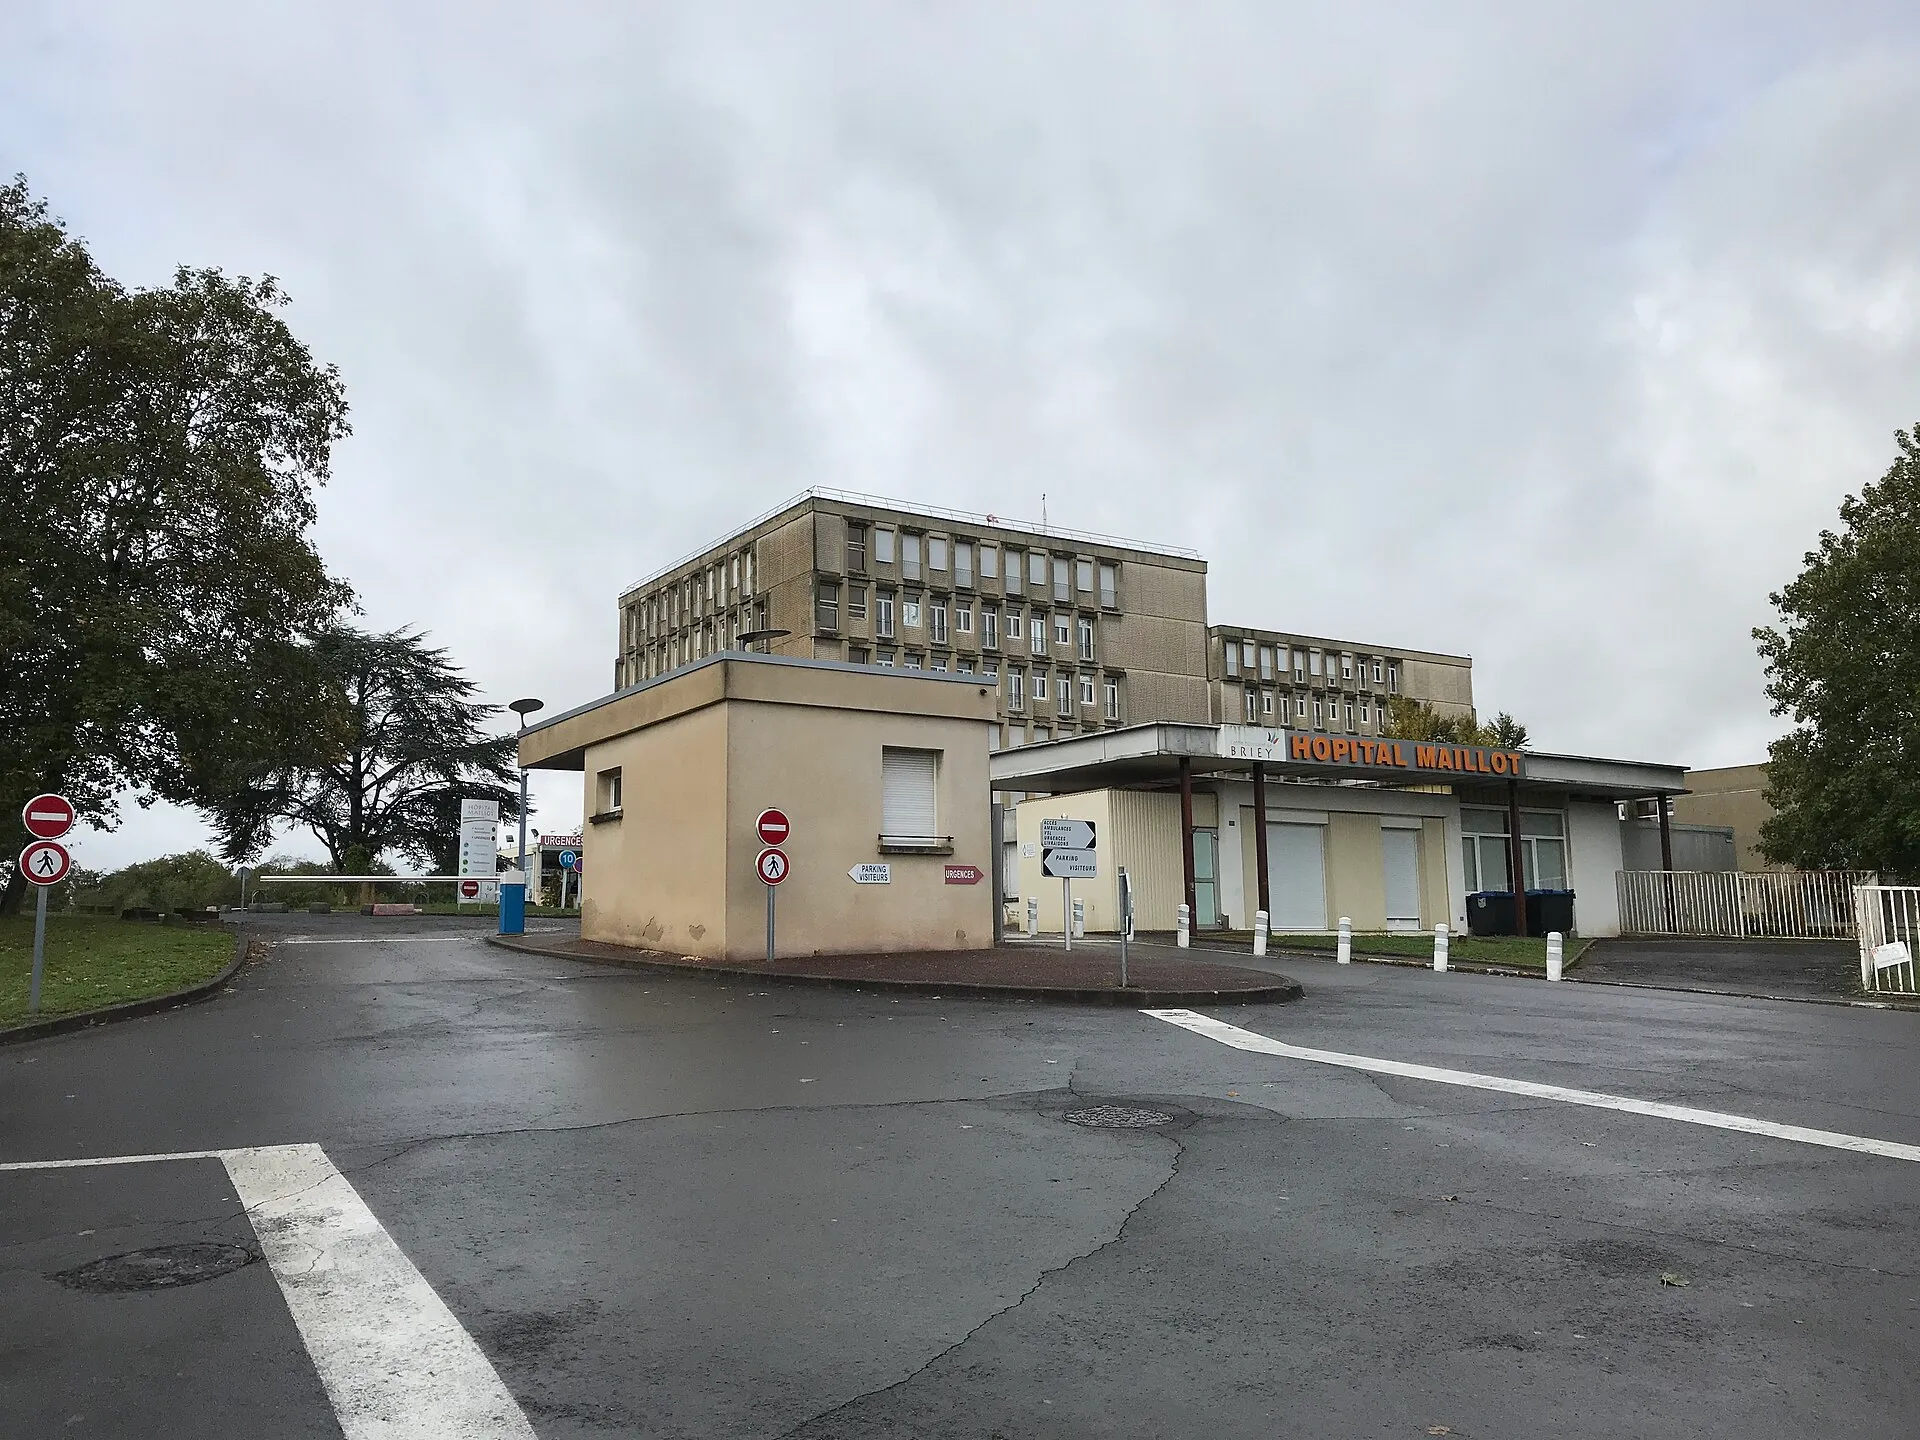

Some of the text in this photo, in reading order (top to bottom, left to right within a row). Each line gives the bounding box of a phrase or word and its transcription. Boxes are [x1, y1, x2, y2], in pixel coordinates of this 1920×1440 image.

[1230, 746, 1272, 758] BRIEY
[1292, 736, 1520, 775] HOPITAL MAILLOT
[563, 854, 573, 863] 10
[861, 865, 887, 873] PARKING
[859, 873, 888, 882] VISITEURS
[945, 870, 975, 879] URGENCES
